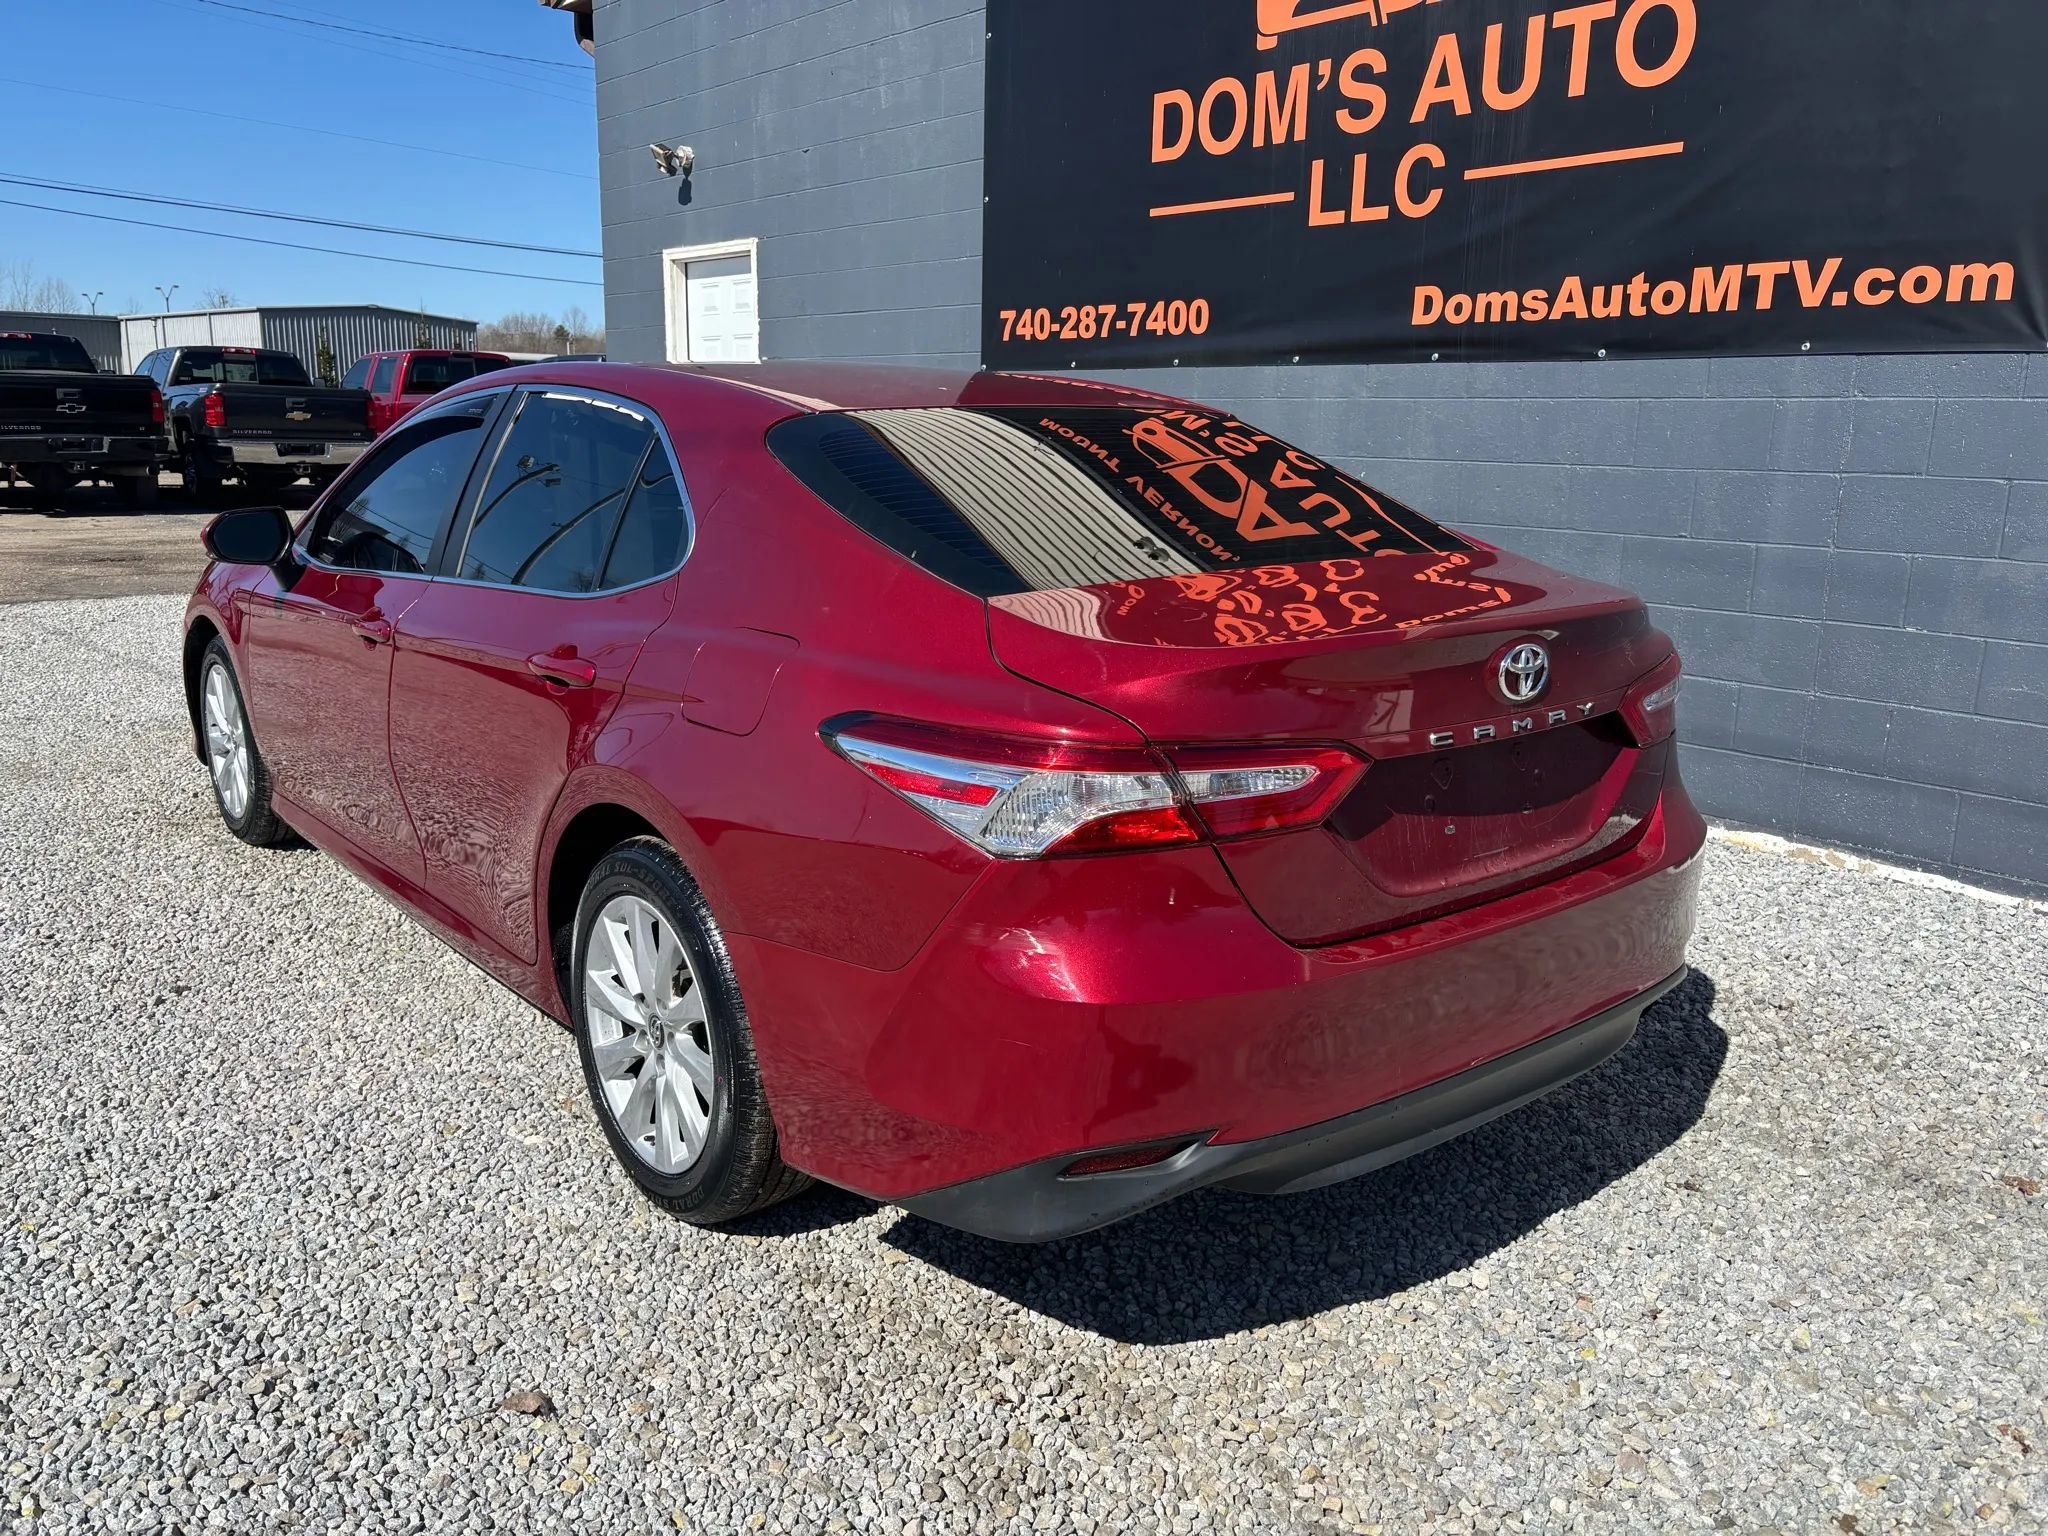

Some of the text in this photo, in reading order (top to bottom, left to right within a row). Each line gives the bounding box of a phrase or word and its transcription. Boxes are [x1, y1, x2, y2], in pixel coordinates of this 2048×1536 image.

[1151, 0, 1697, 163] DOM'S AUTO
[1308, 143, 1446, 227] LLC
[1000, 298, 1210, 341] 740-287-7400
[1411, 256, 2015, 326] DomsAutoMTV.com
[1429, 702, 1595, 746] CAMRY
